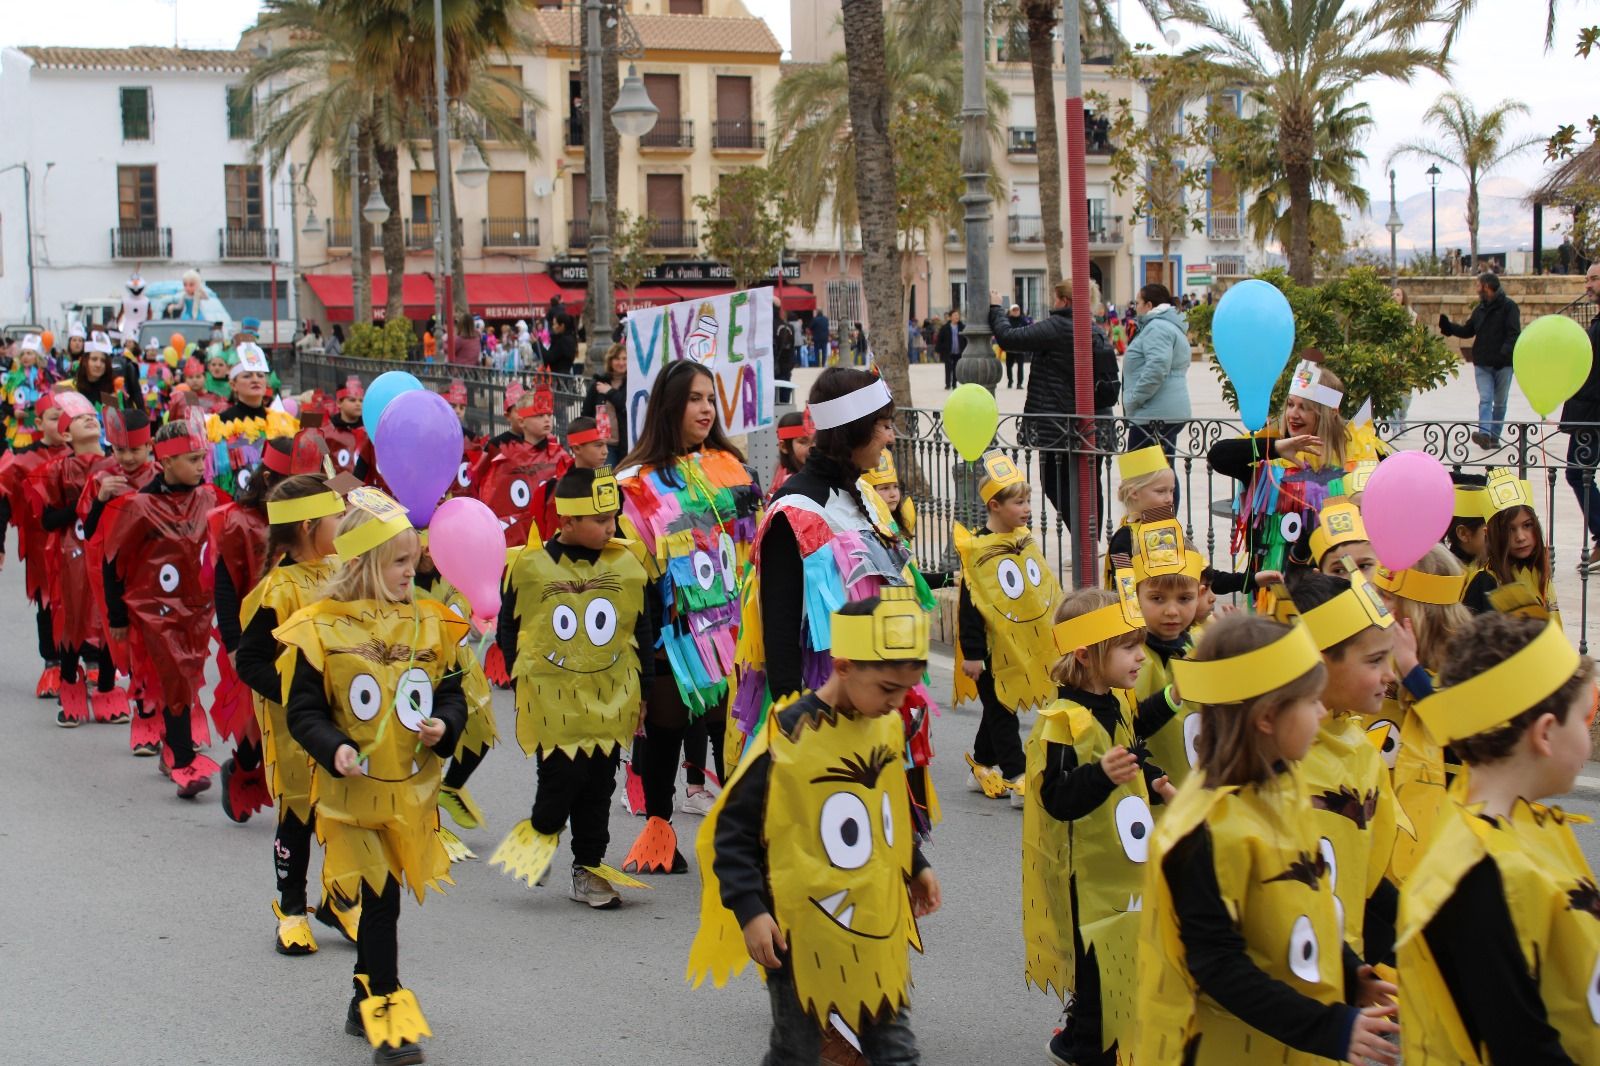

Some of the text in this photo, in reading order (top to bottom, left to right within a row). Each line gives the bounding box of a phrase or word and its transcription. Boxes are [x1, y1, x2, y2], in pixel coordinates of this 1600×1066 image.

[709, 266, 734, 277] HOTE
[485, 306, 546, 318] RESTAURANTE
[728, 290, 769, 363] EL
